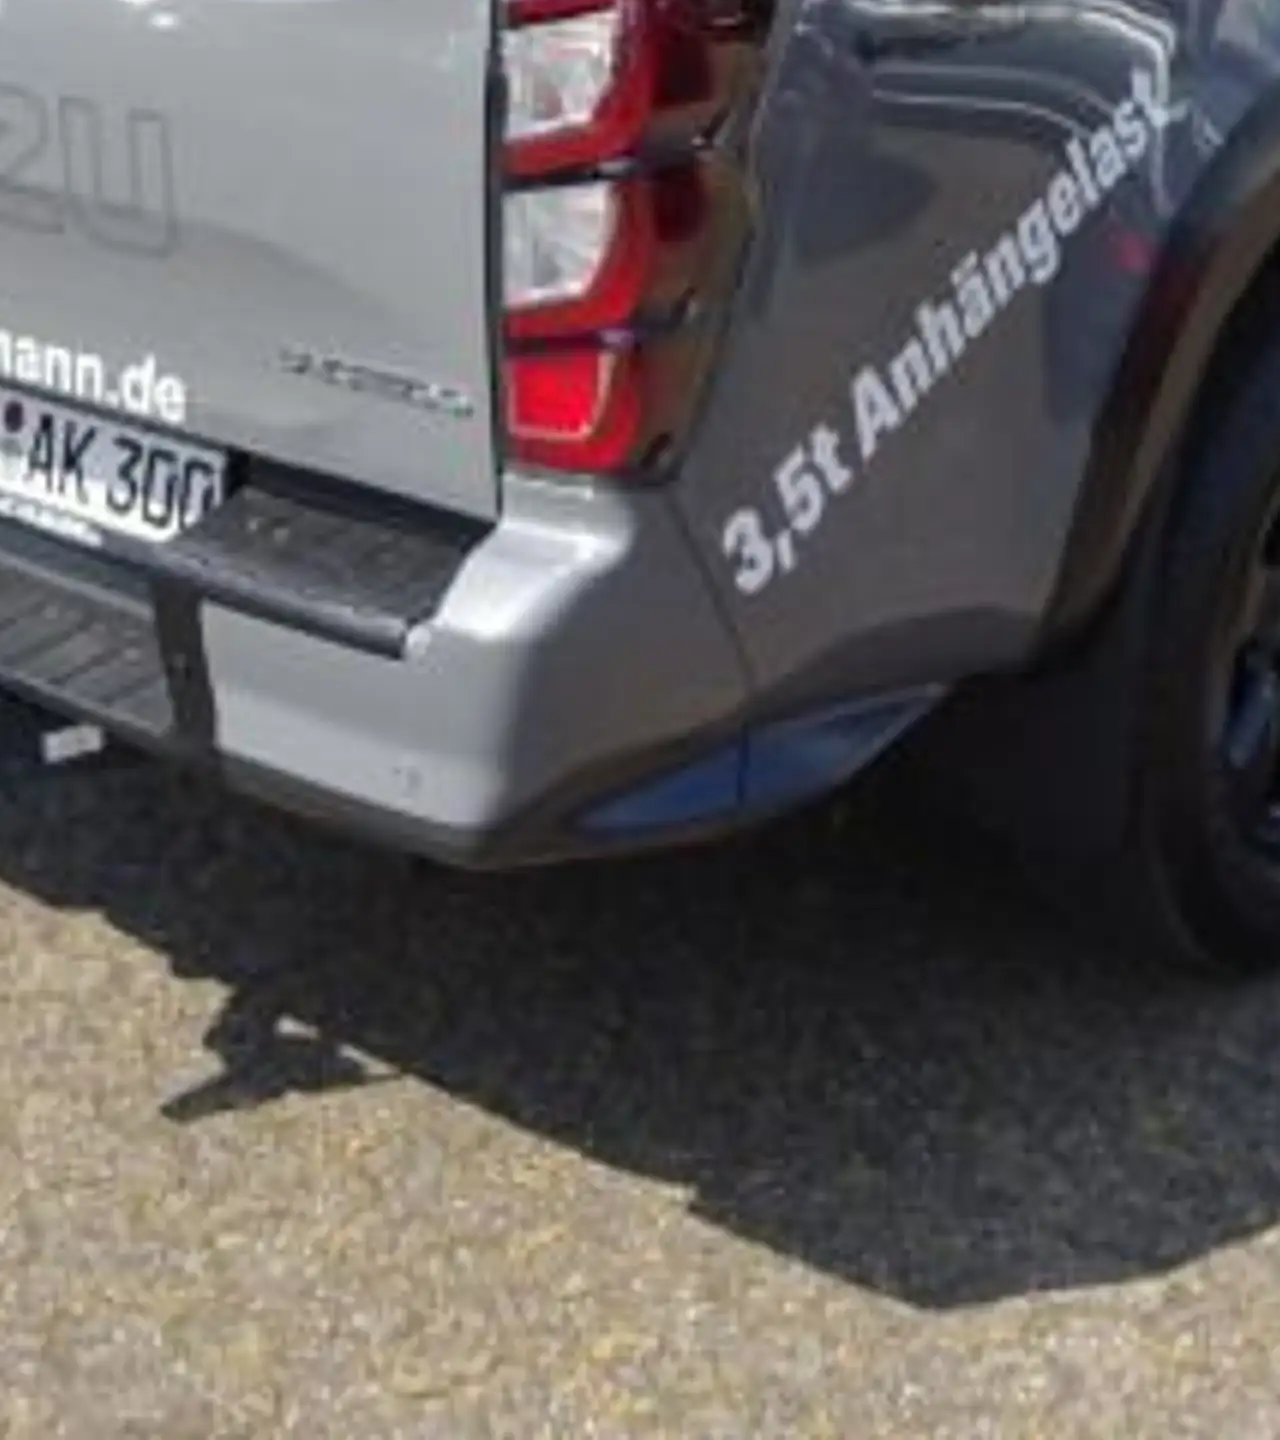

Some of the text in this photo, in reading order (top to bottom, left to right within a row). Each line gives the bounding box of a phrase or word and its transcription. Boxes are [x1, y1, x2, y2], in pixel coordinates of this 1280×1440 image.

[26, 412, 96, 506] AK
[105, 435, 208, 530] 300
[720, 420, 854, 594] 3,5t
[850, 66, 1186, 464] Anhängelast
